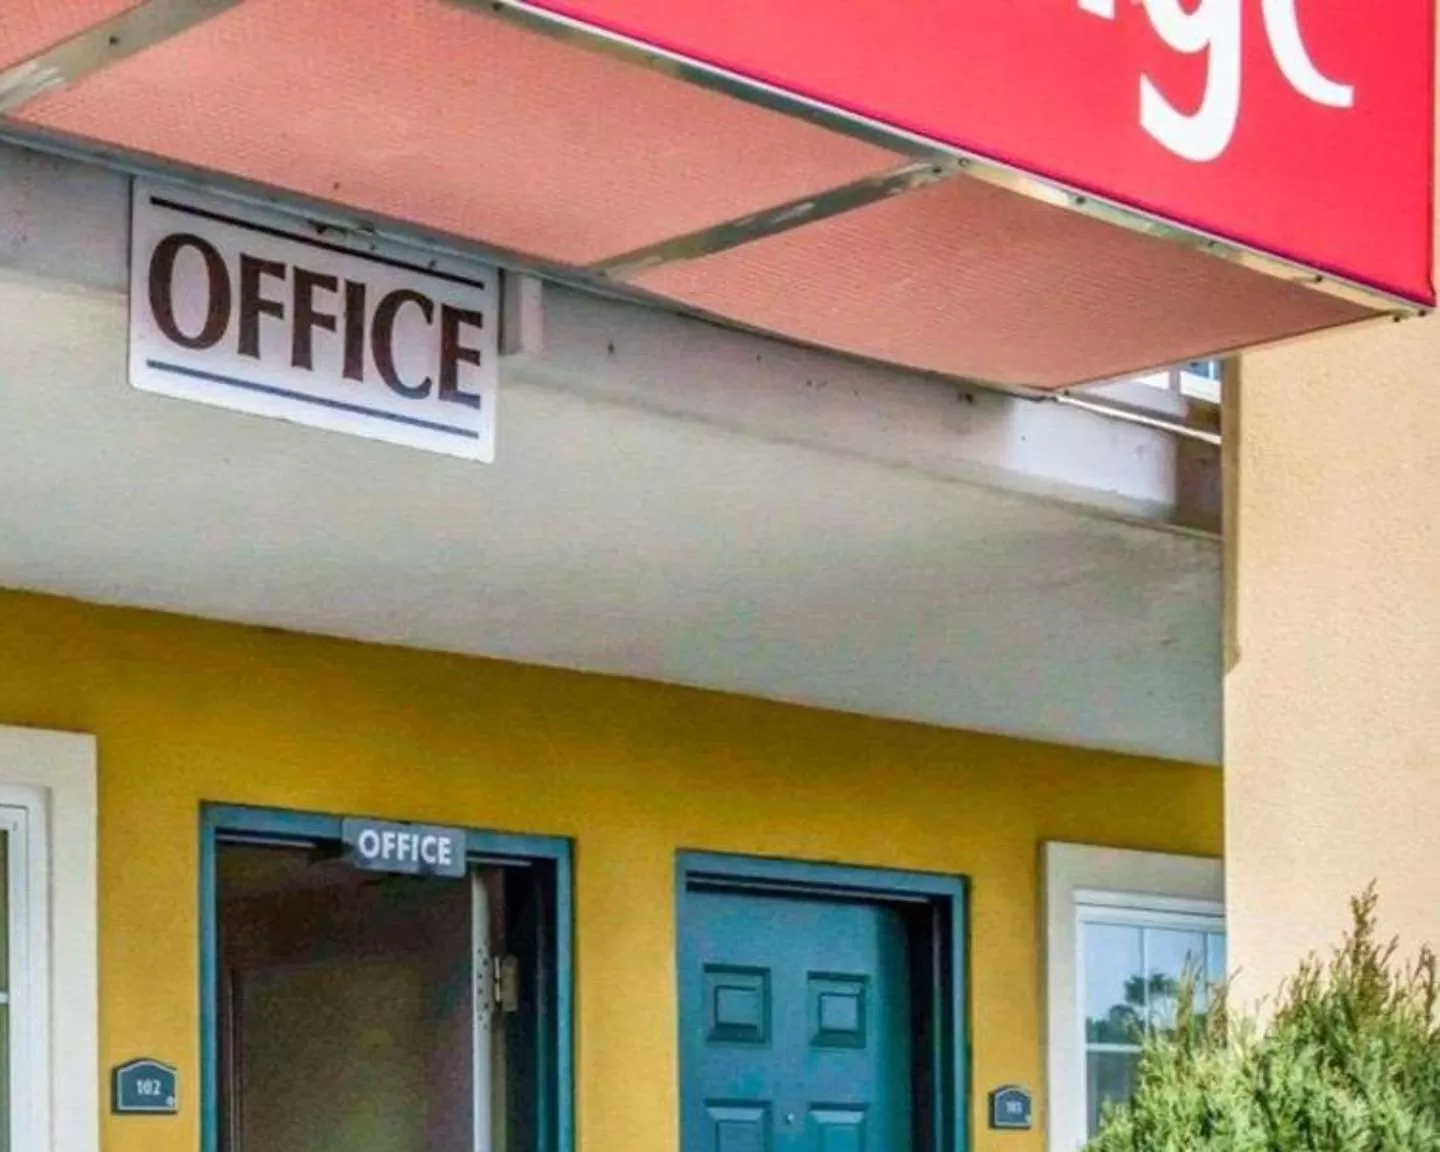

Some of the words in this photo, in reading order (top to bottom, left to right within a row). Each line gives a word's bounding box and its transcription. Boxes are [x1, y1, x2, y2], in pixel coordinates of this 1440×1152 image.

[148, 232, 484, 410] OFFICE
[358, 828, 453, 866] OFFICE
[136, 1079, 161, 1096] 102
